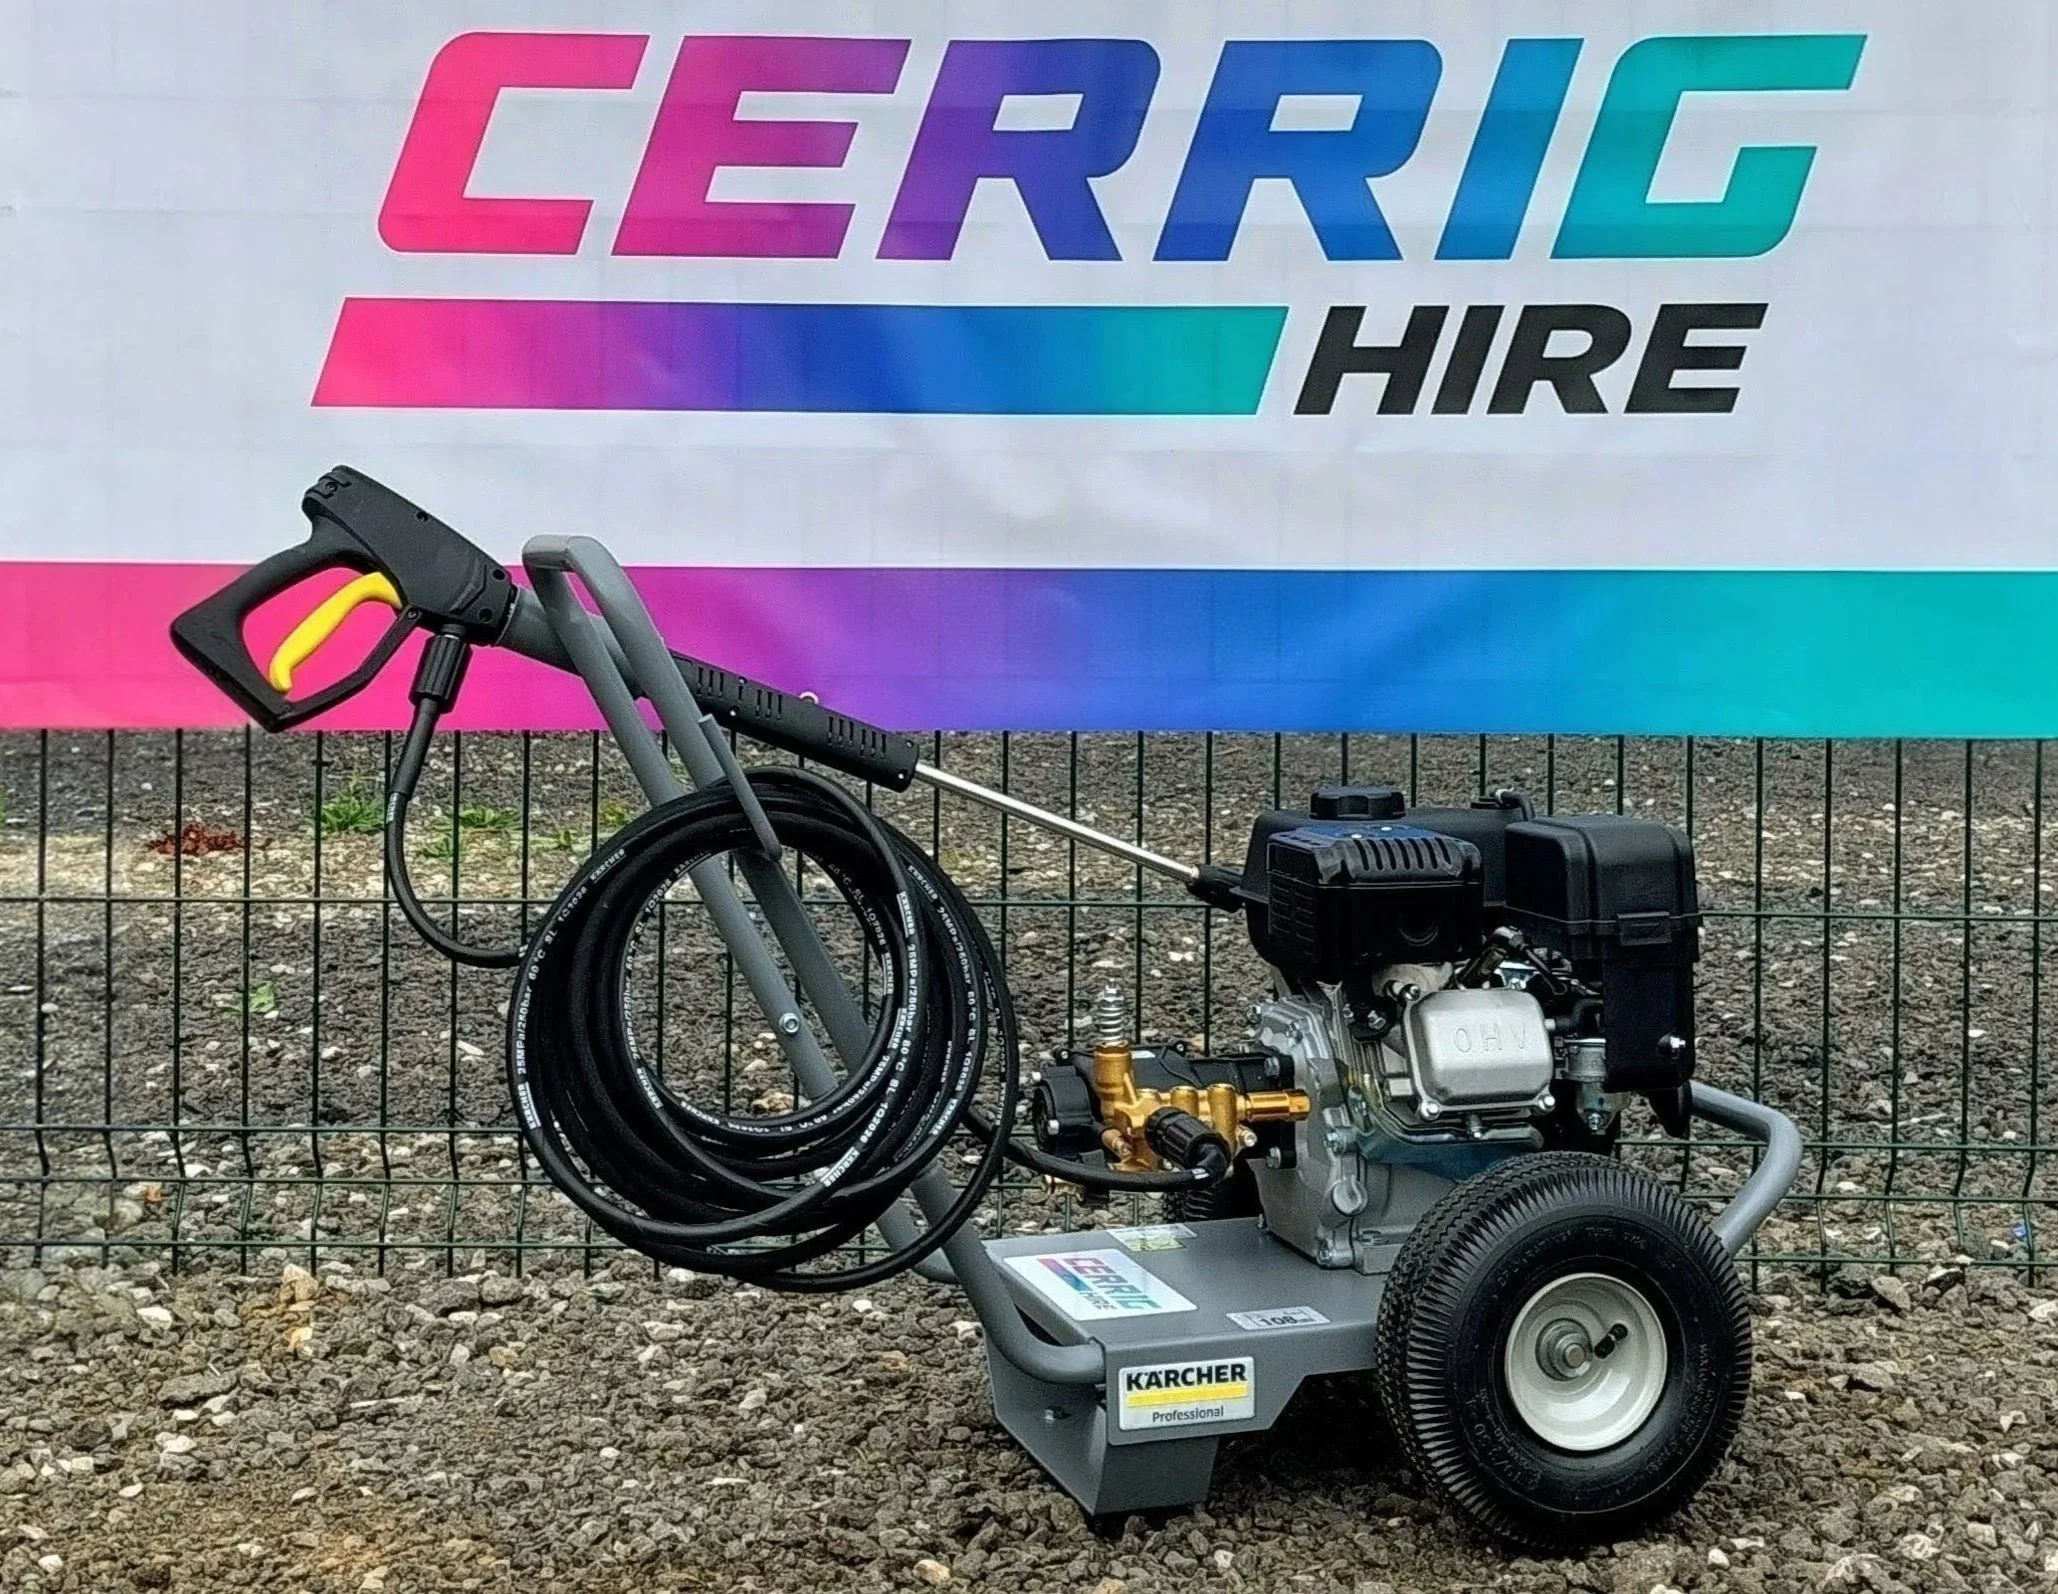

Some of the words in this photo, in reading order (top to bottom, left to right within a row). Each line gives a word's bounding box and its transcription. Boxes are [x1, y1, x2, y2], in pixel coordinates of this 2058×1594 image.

[378, 32, 1867, 261] CERRIG
[1293, 303, 1768, 415] HIRE
[1126, 1363, 1248, 1391] KÄRCHER
[1152, 1405, 1225, 1423] Professional
